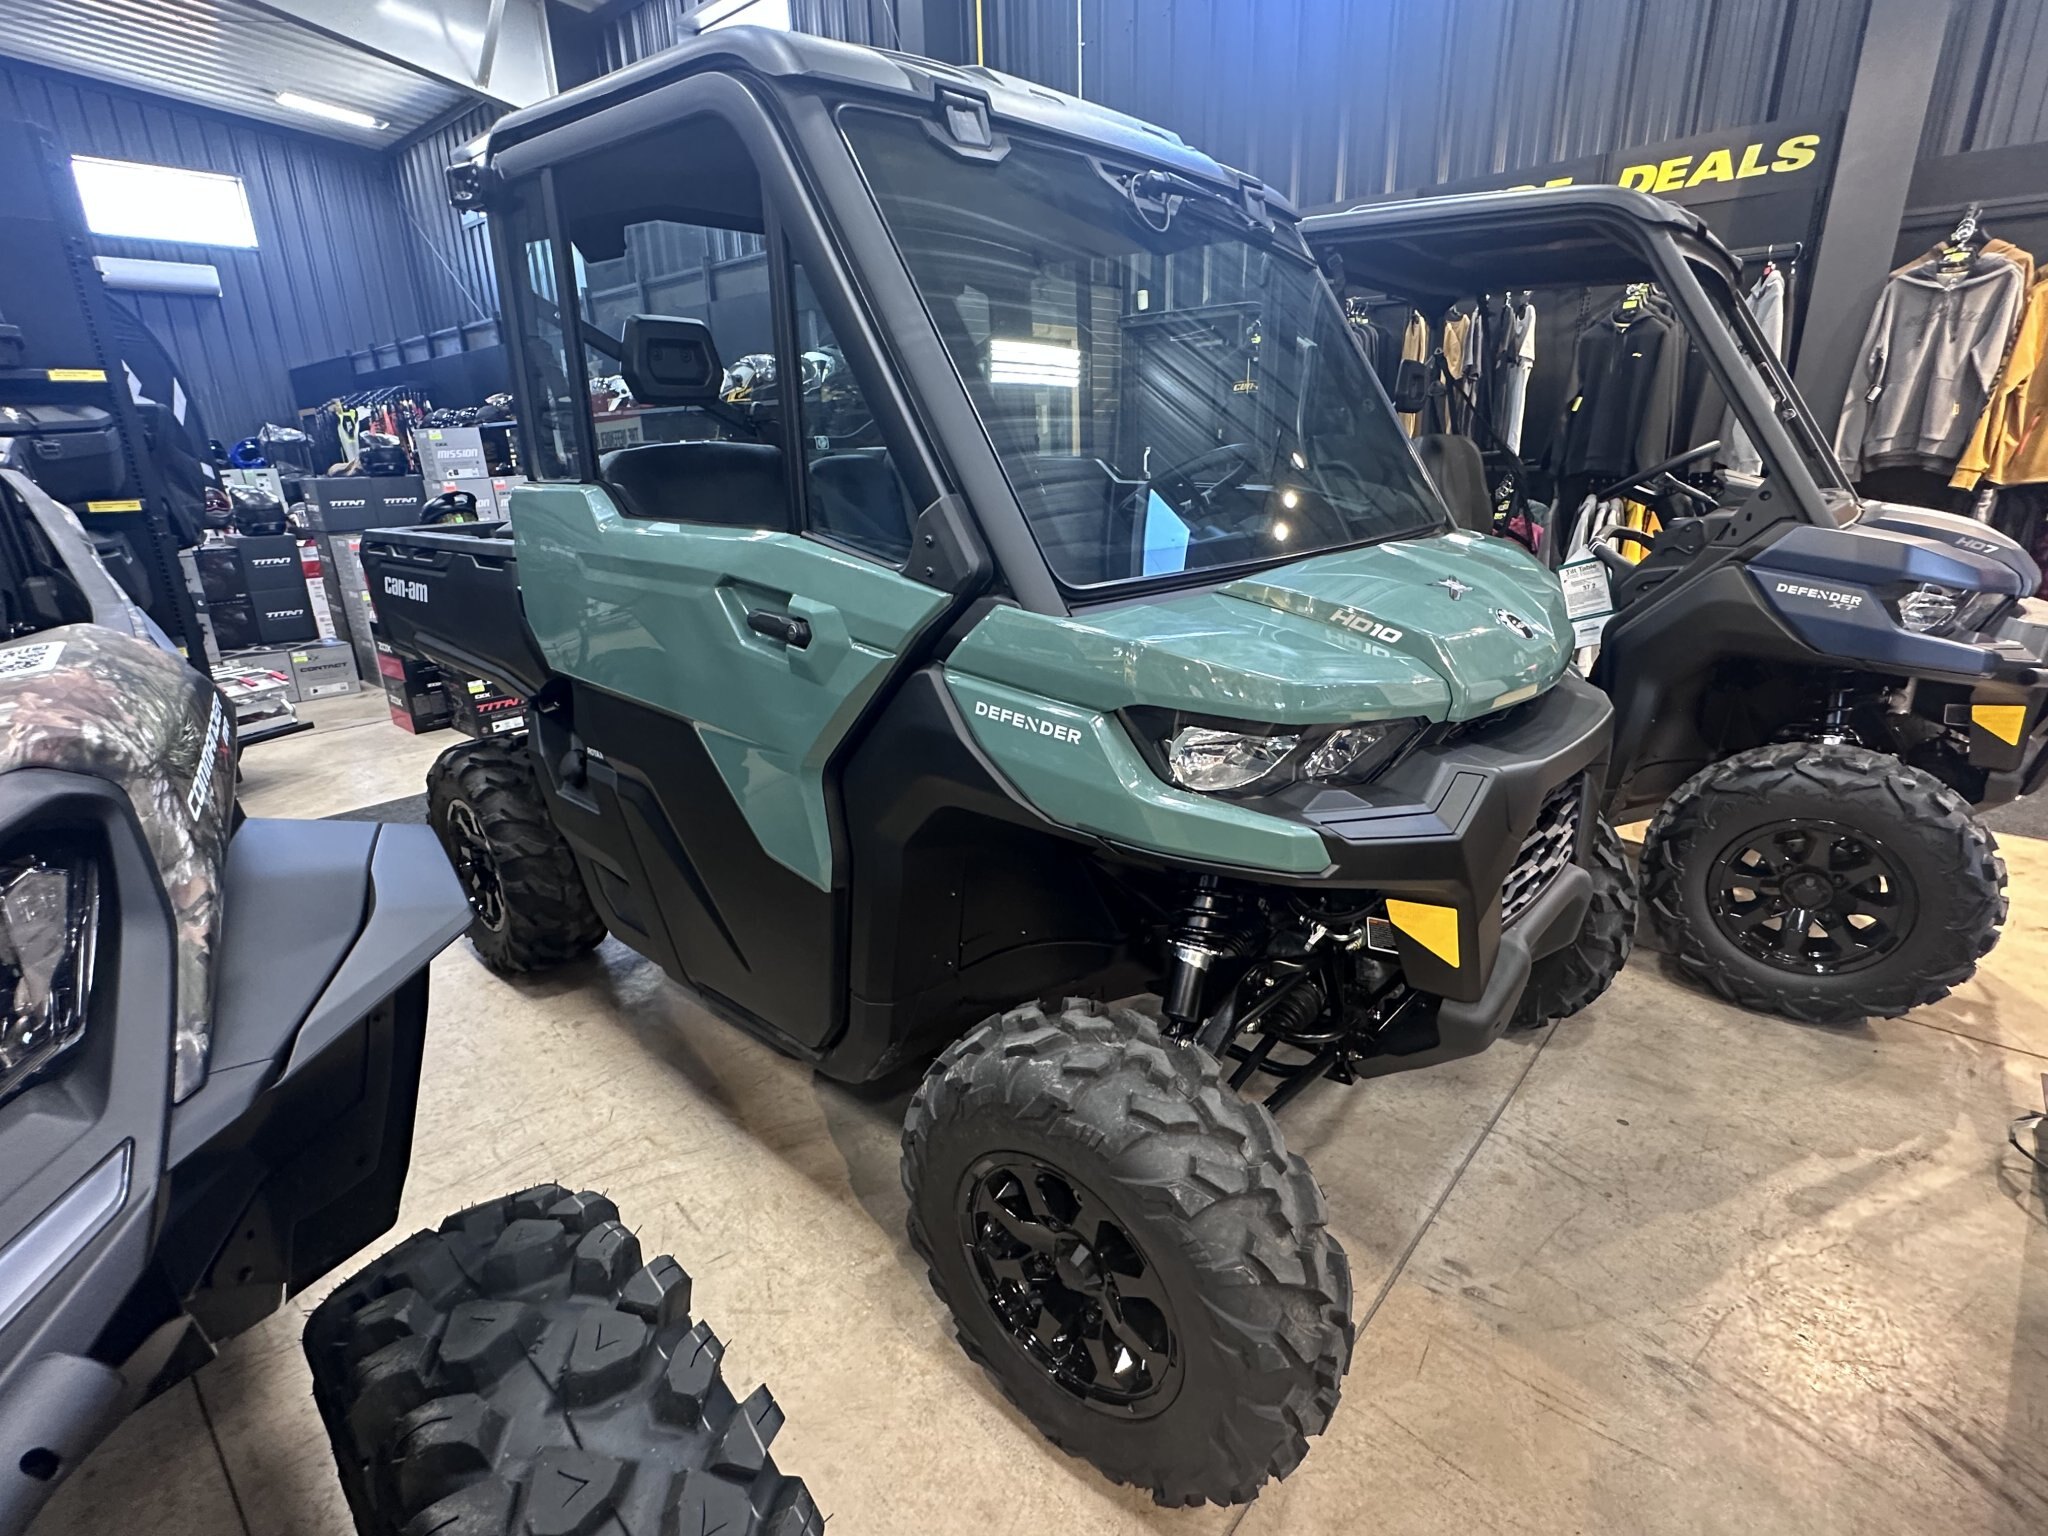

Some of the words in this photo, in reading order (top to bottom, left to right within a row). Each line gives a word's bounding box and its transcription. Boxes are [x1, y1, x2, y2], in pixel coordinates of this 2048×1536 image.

[1618, 134, 1821, 194] DEALS
[329, 499, 366, 507] TITAN
[383, 497, 418, 505] TITAN
[1954, 536, 2000, 554] HD7
[252, 557, 291, 566] TITAN
[384, 576, 429, 603] can-am
[1776, 583, 1863, 606] DEFENDER
[265, 609, 304, 619] TITAN
[1329, 609, 1403, 644] HD10
[300, 662, 348, 673] CONTACT
[476, 697, 518, 713] TITAN
[975, 701, 1083, 745] DEFENDER
[187, 691, 222, 822] COMMANDER
